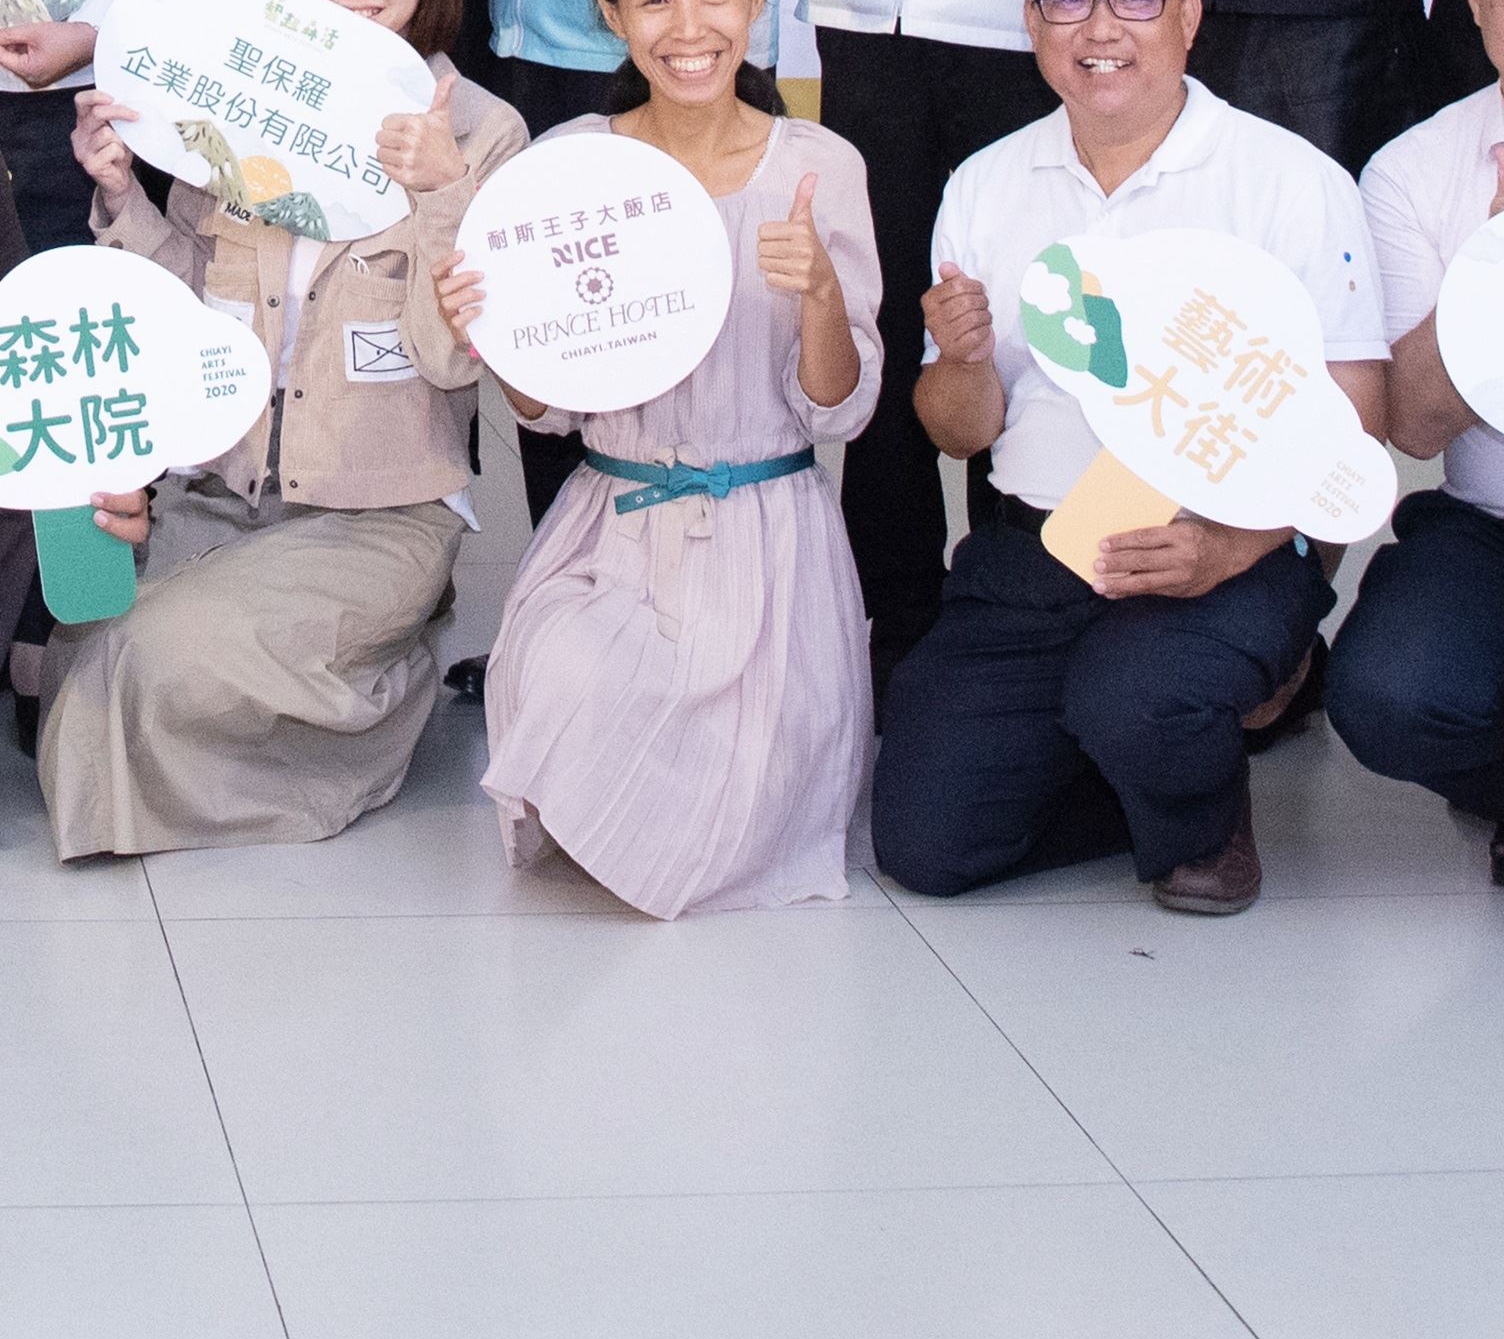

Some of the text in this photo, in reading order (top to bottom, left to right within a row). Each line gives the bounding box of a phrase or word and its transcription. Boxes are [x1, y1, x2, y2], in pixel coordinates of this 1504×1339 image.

[223, 36, 332, 111] 聖保羅
[120, 45, 392, 196] 企業股份有限公司
[224, 201, 252, 222] MADE
[486, 191, 673, 251] 耐斯王子大飯店
[551, 233, 620, 268] NICE
[513, 289, 696, 350] PRINCE HOTEL
[199, 345, 232, 358] CHIAYI
[200, 358, 226, 370] ARTS
[1160, 287, 1309, 419] 藝術
[202, 367, 247, 382] FESTIVAL
[204, 383, 237, 400] 2020
[6, 387, 153, 472] 大院
[1113, 364, 1258, 485] 大街
[1336, 459, 1366, 485] CHIAYI
[1311, 491, 1343, 519] 2020
[1320, 477, 1360, 515] FESTIVAL
